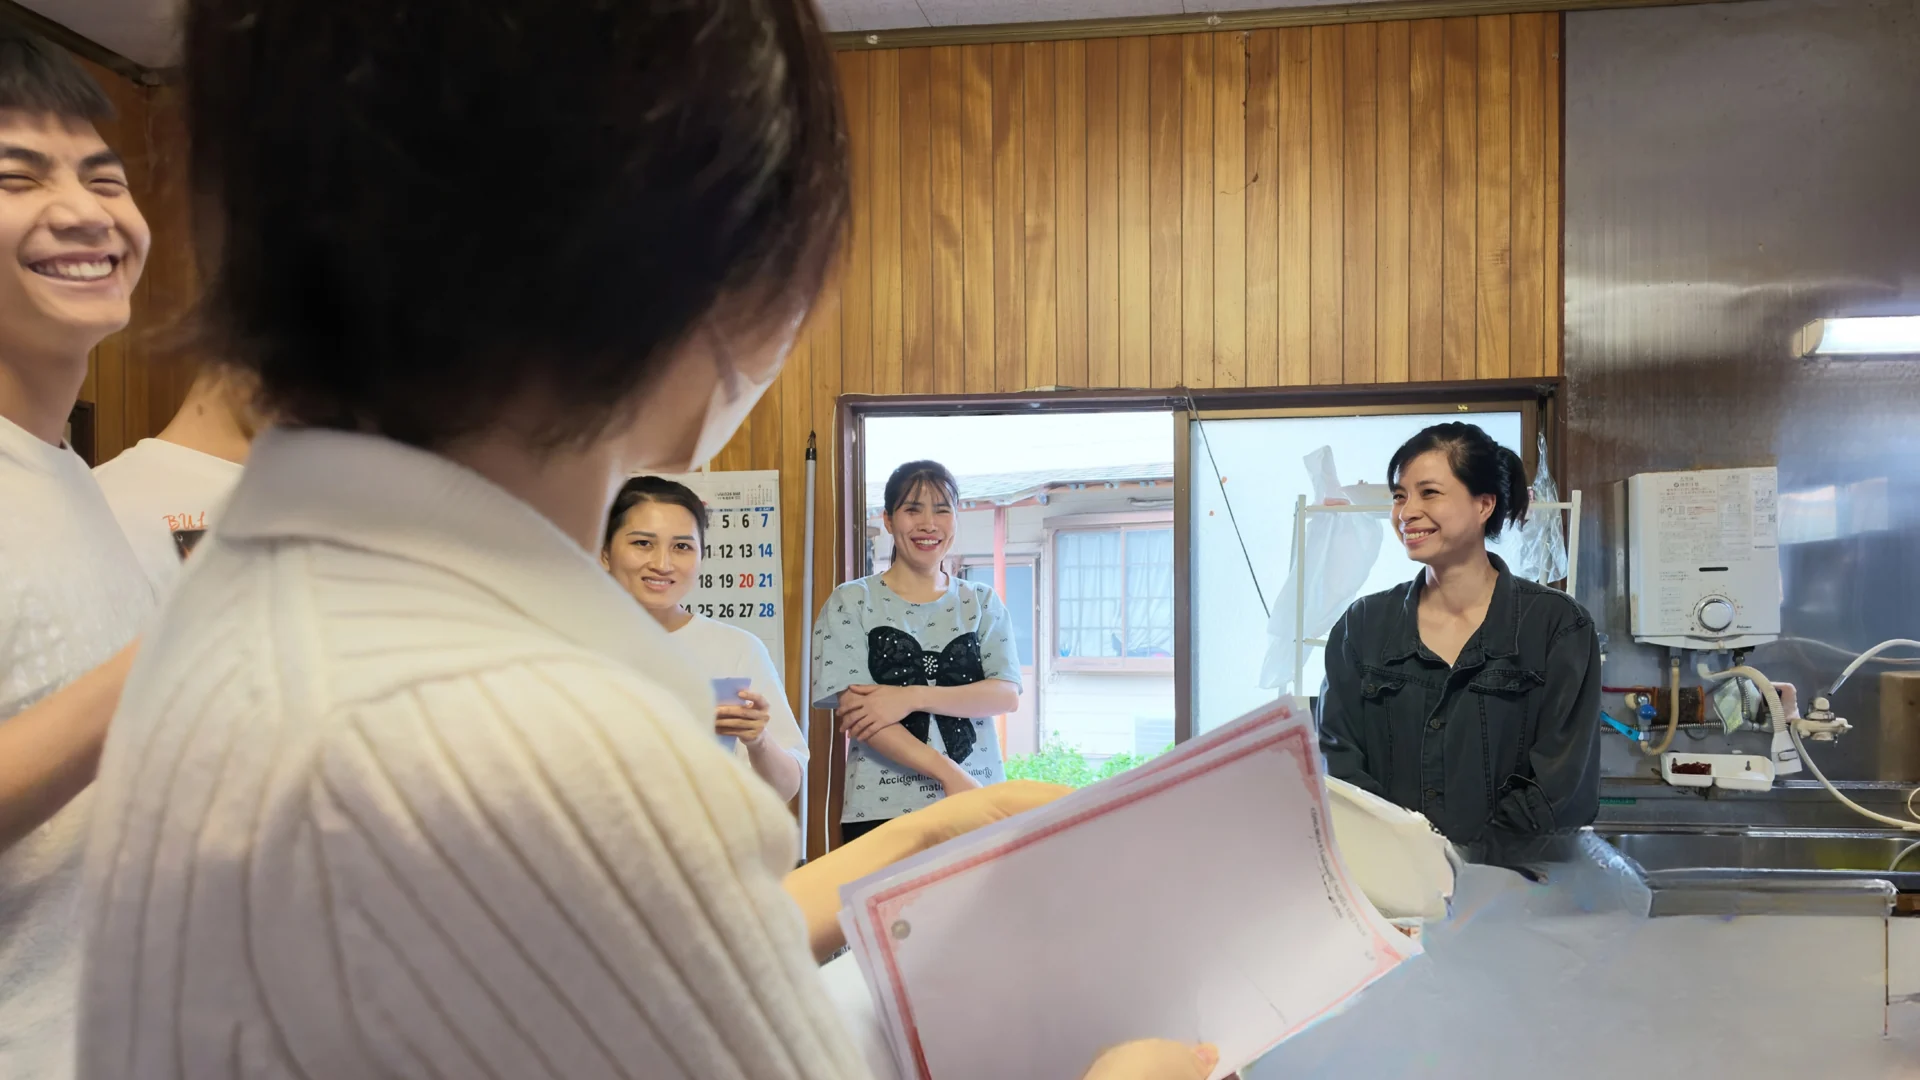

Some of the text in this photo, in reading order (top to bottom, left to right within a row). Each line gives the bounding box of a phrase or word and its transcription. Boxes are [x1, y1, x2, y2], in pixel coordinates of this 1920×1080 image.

[722, 513, 769, 529] 5 6 7
[719, 544, 733, 558] 12
[739, 543, 753, 558] 13
[758, 543, 773, 558] 14
[698, 573, 773, 588] 18 19 20 21
[698, 604, 714, 618] 25
[718, 603, 734, 618] 26
[739, 603, 754, 618] 27
[758, 602, 774, 617] 28
